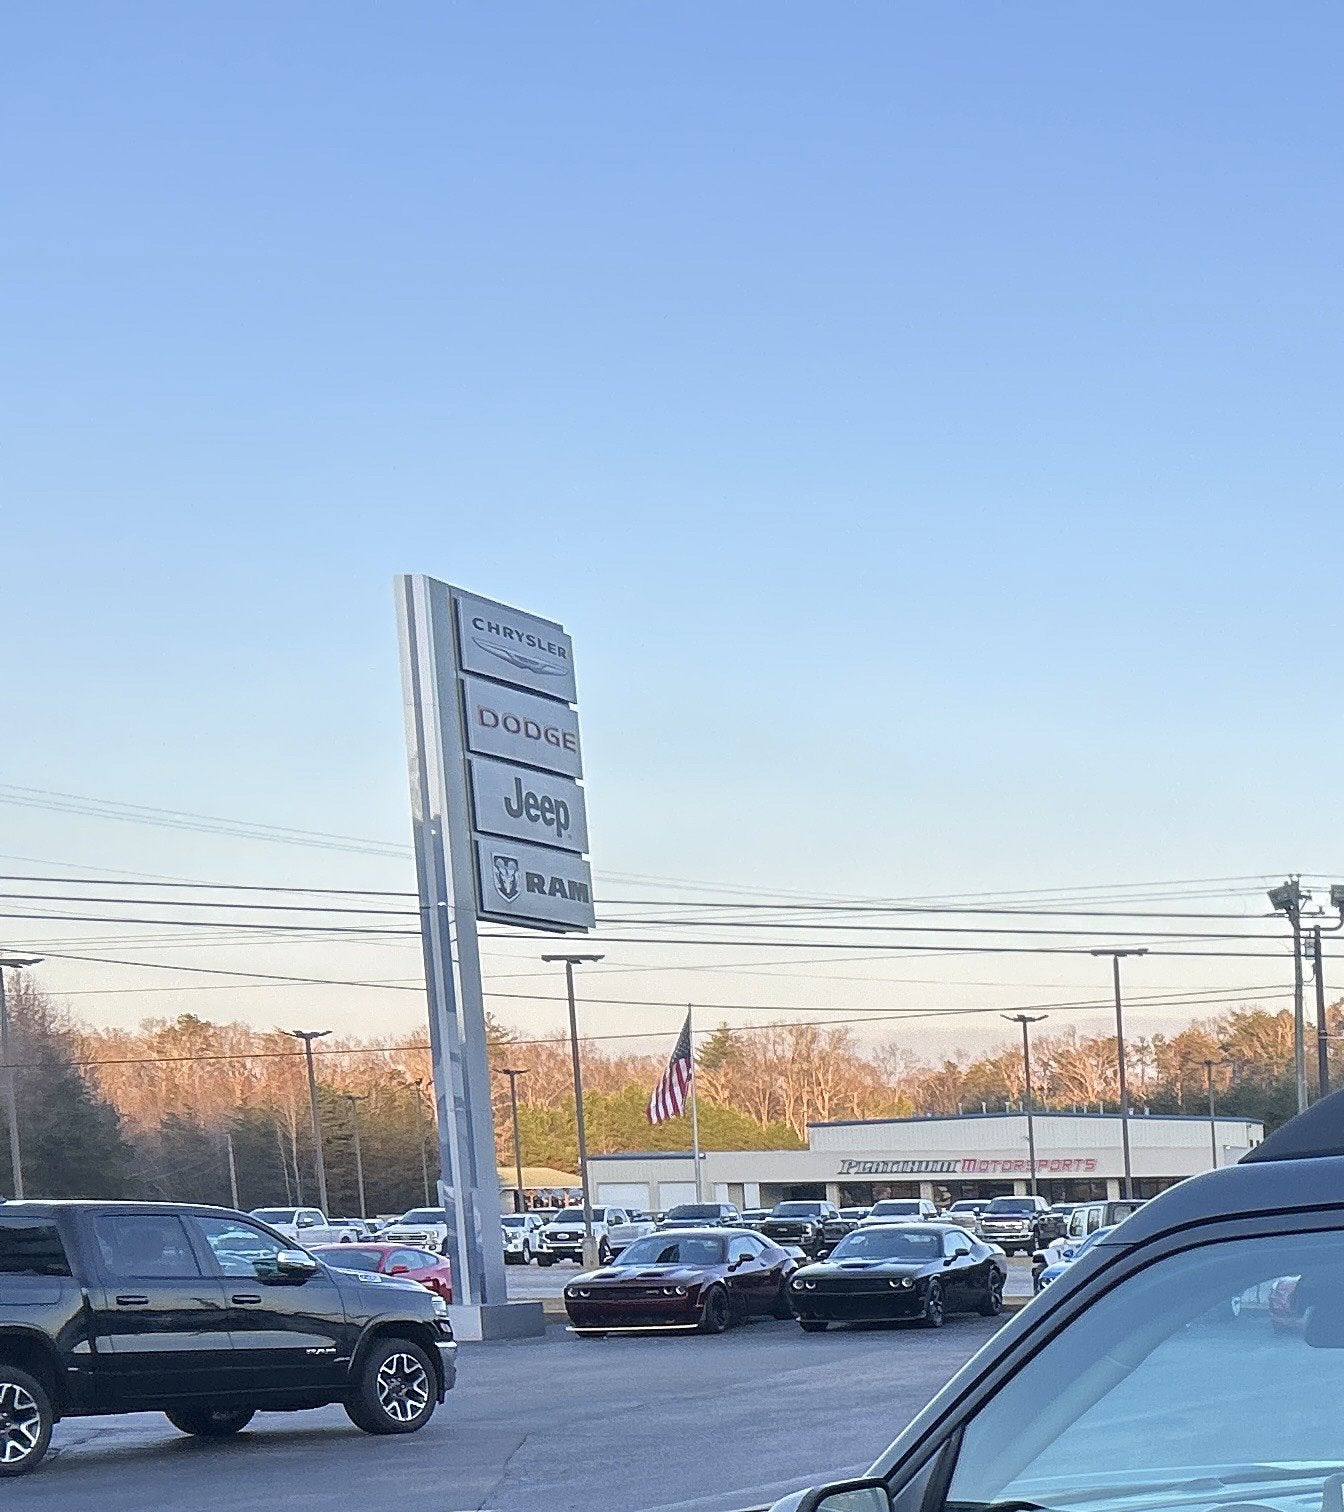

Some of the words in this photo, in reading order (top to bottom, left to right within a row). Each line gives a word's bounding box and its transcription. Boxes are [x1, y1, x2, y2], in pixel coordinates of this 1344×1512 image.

[471, 616, 567, 661] CHRYSLER
[477, 705, 577, 752] DODGE
[503, 777, 570, 838] Jeep
[525, 871, 589, 904] RAM
